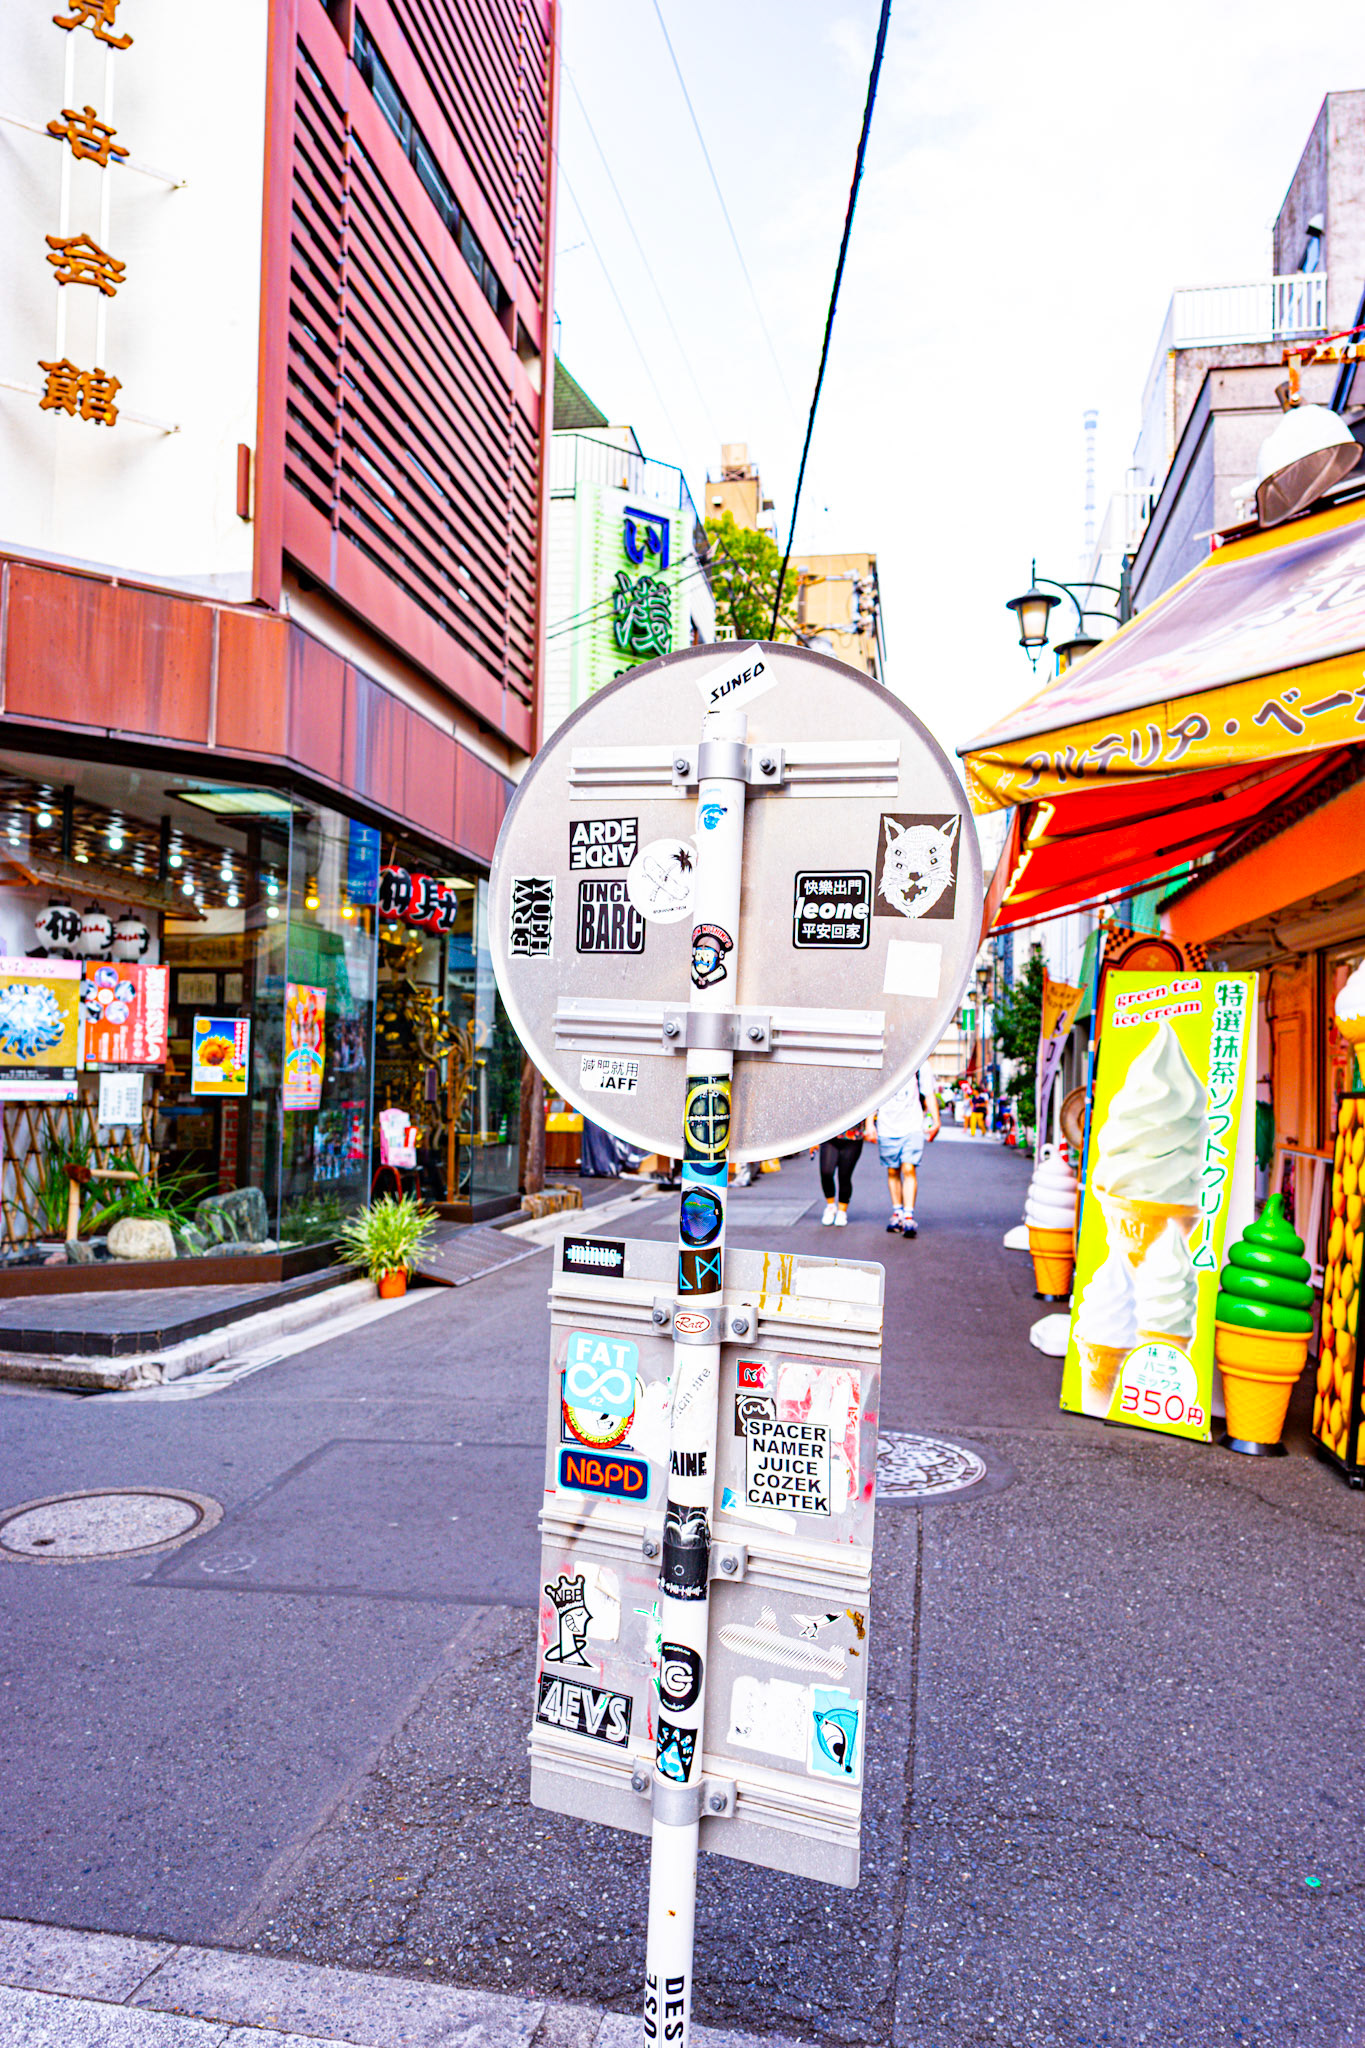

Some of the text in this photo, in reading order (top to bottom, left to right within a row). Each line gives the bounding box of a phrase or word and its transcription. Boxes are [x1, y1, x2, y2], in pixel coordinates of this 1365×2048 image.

[1018, 671, 1365, 789] アルテリア・ベー
[571, 819, 637, 845] ARDE
[804, 879, 863, 896] 快樂出門
[794, 896, 870, 920] leone
[802, 923, 862, 940] 平安回家
[1117, 980, 1200, 1006] green tea
[1115, 1002, 1201, 1026] ice cream
[1192, 983, 1245, 1269] 特選抹茶ソフトクリーム
[575, 1337, 631, 1369] FAT
[588, 1395, 605, 1408] 42
[1122, 1385, 1204, 1426] 350円
[749, 1421, 827, 1442] SPACER
[753, 1438, 824, 1459] NAMER
[566, 1455, 644, 1492] NBPD
[669, 1449, 708, 1477] AINE
[758, 1456, 818, 1476] JUICE
[754, 1473, 822, 1494] COZEK
[748, 1489, 829, 1512] CAPTEK
[540, 1679, 628, 1743] 4EVS
[664, 1974, 686, 2048] DES
